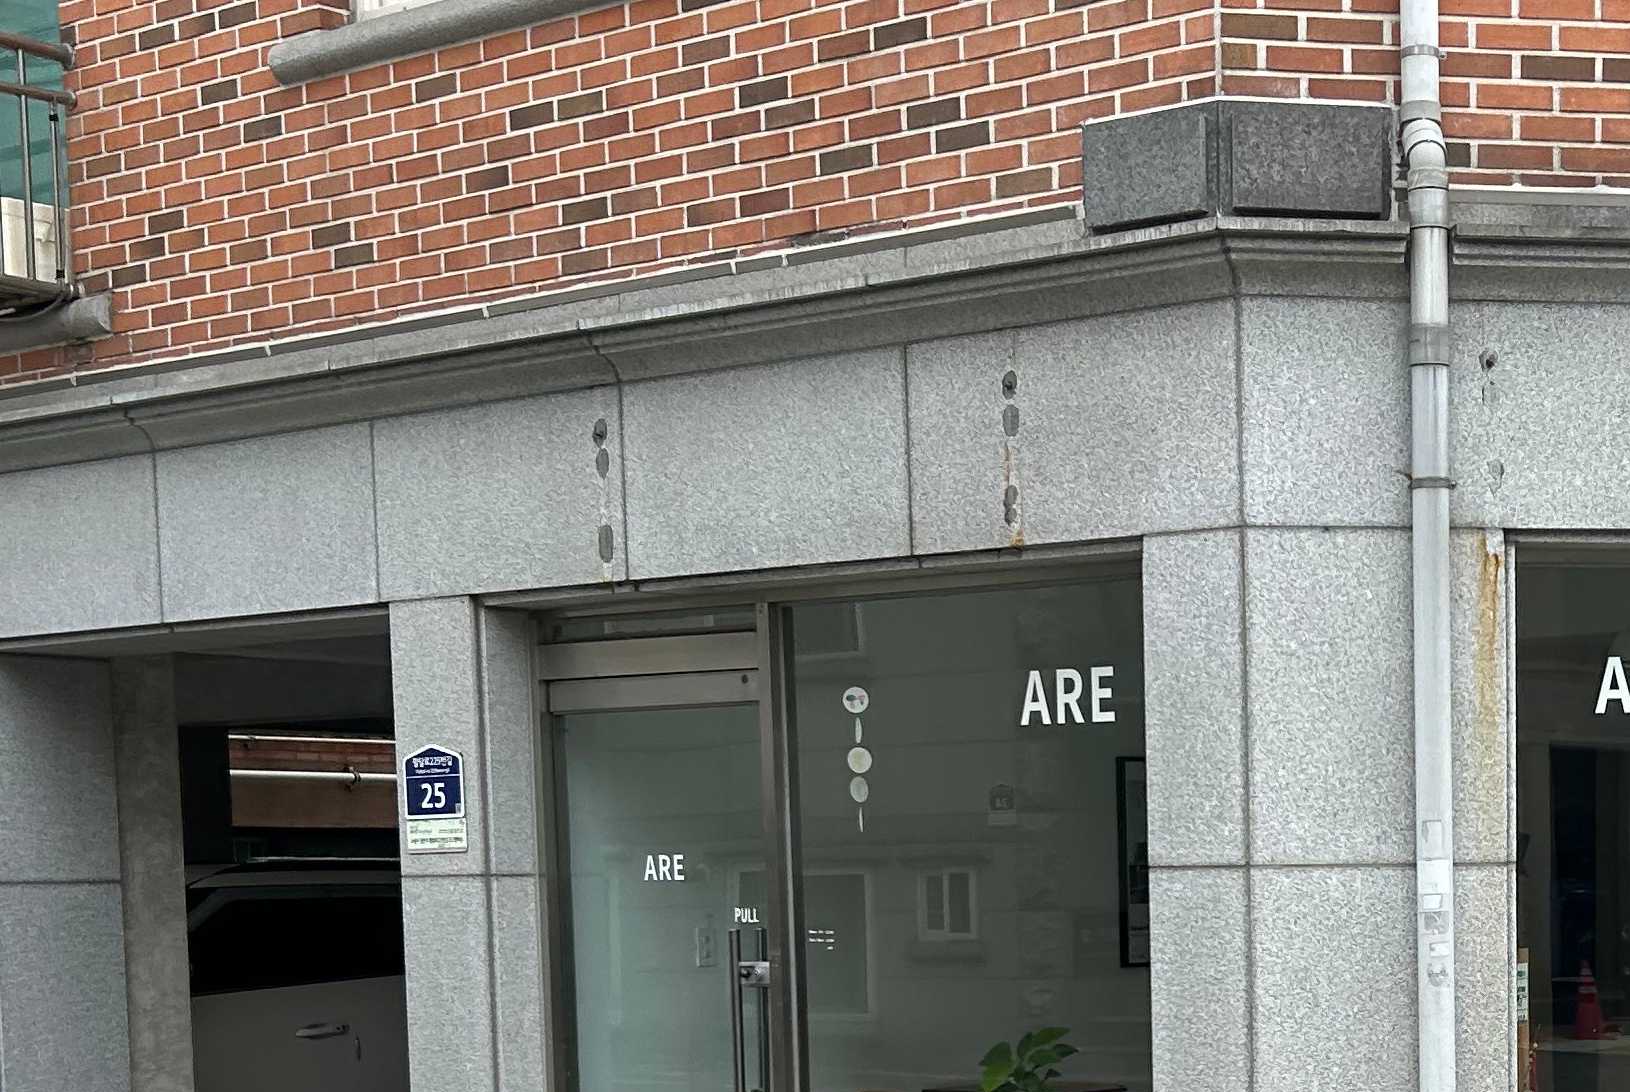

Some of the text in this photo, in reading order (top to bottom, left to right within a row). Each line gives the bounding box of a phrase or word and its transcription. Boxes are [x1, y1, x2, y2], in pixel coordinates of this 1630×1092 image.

[1020, 666, 1116, 726] ARE
[421, 782, 446, 809] 25
[643, 854, 685, 881] ARE
[734, 907, 759, 923] PULL
